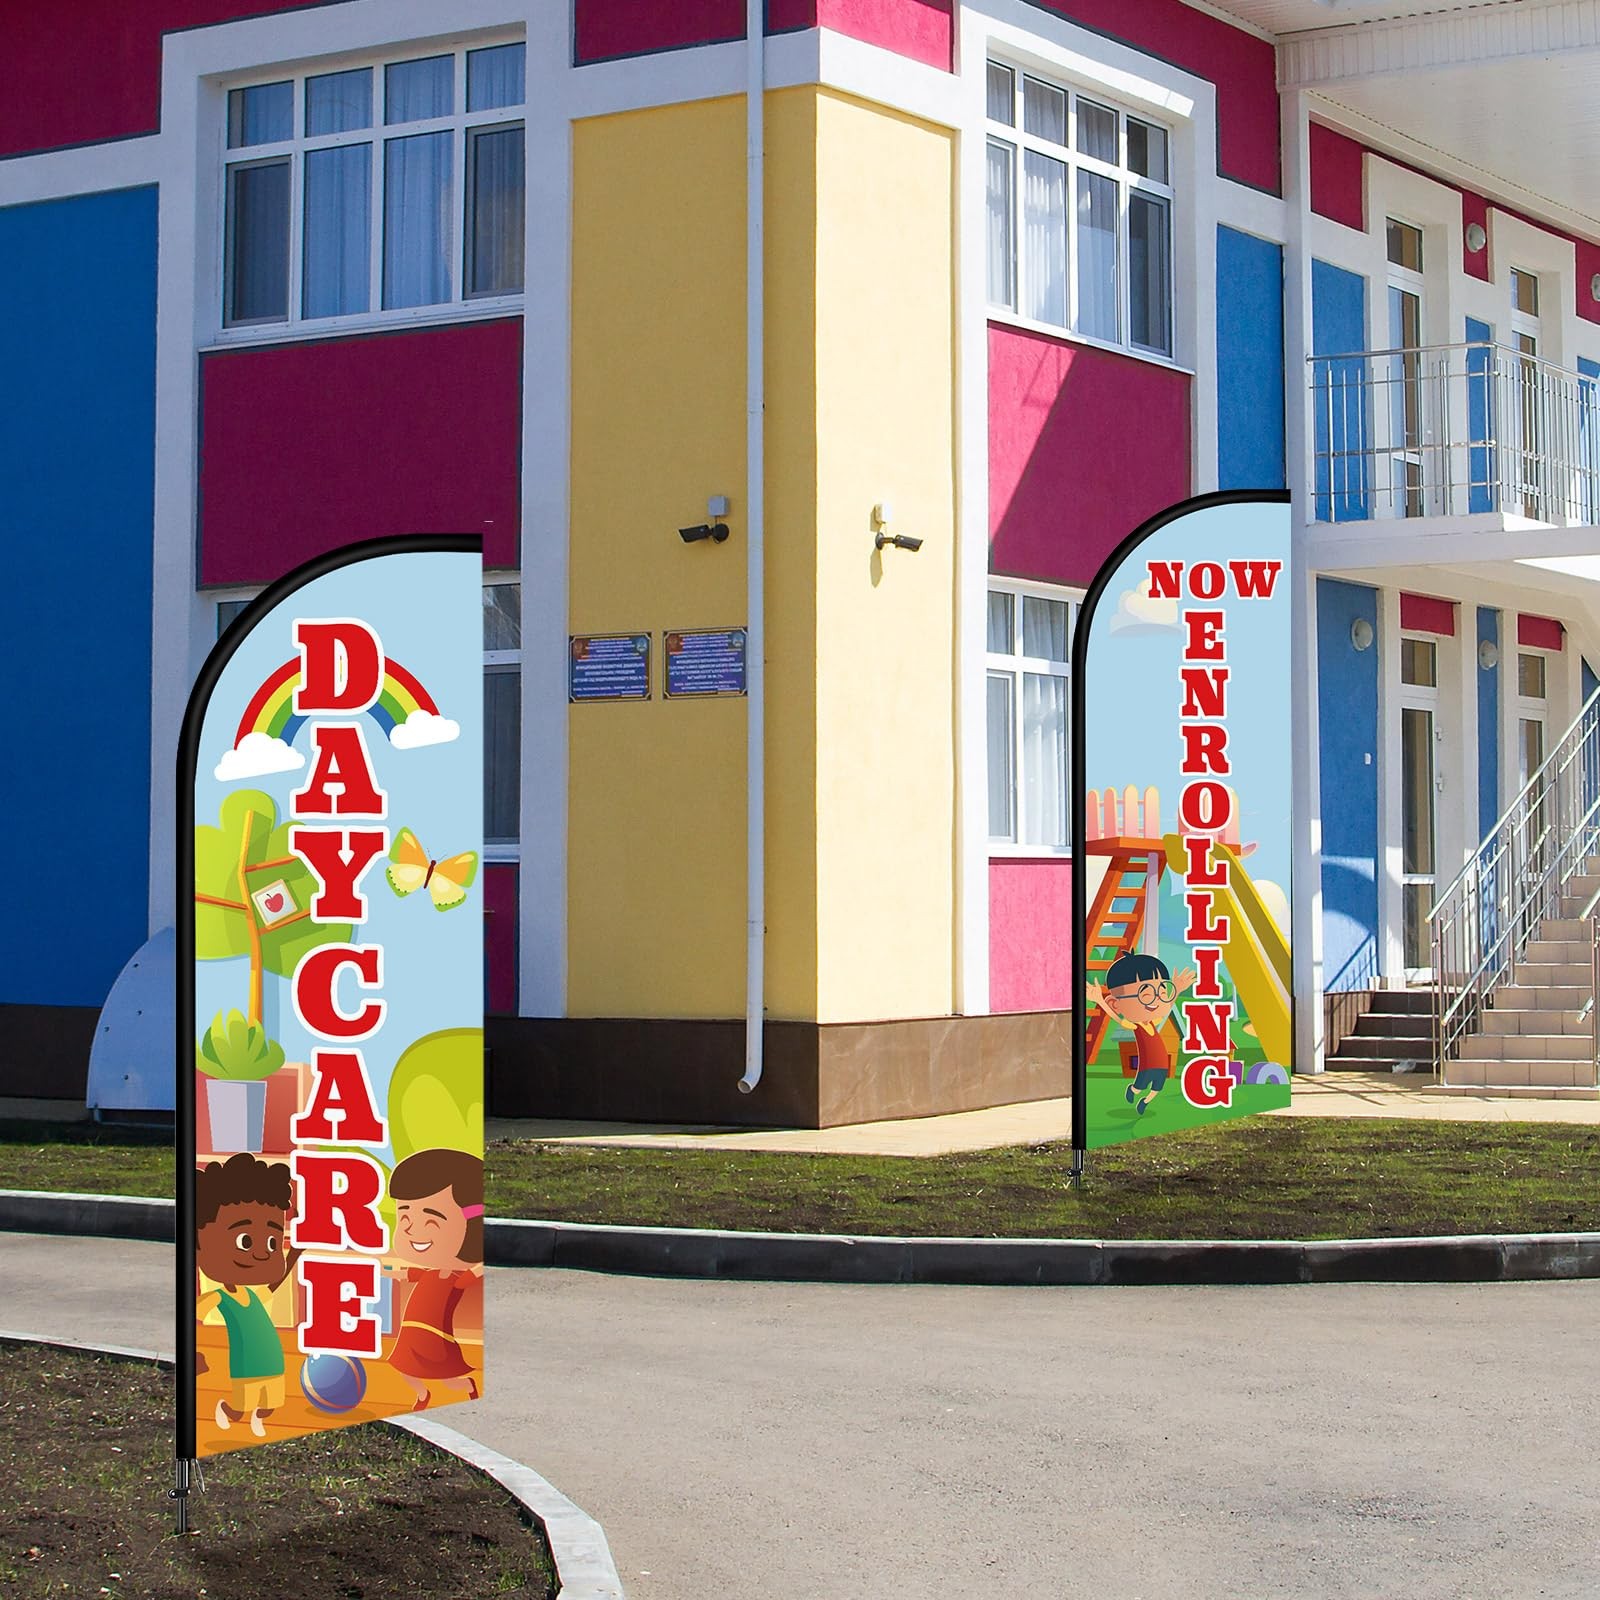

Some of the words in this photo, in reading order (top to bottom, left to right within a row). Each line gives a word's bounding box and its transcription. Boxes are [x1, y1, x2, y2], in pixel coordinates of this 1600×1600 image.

[1147, 559, 1282, 600] NOW
[292, 620, 387, 1354] DAYCARE
[1180, 610, 1234, 1106] ENROLLING
